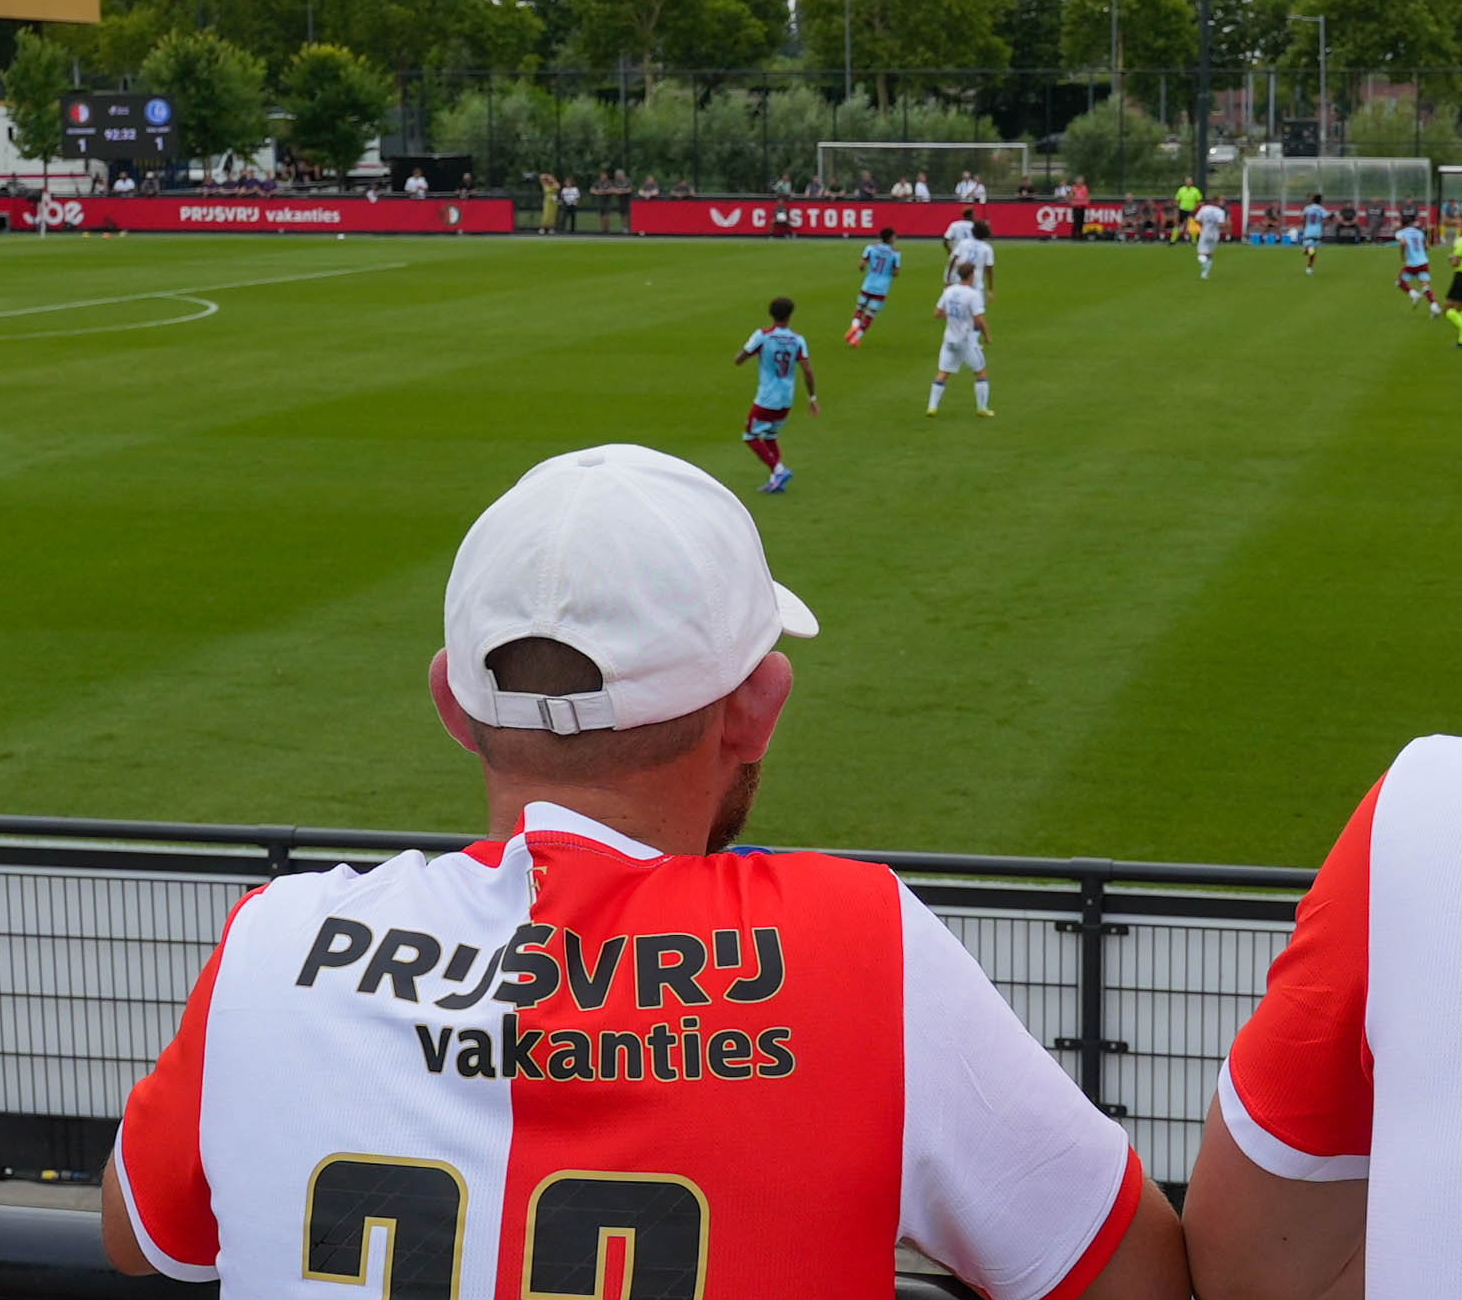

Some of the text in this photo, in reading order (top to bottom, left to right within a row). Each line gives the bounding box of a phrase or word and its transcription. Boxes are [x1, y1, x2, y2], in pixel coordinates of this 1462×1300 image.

[265, 205, 341, 223] vakanties
[752, 208, 875, 228] CSTORE
[414, 1012, 795, 1081] vakanties
